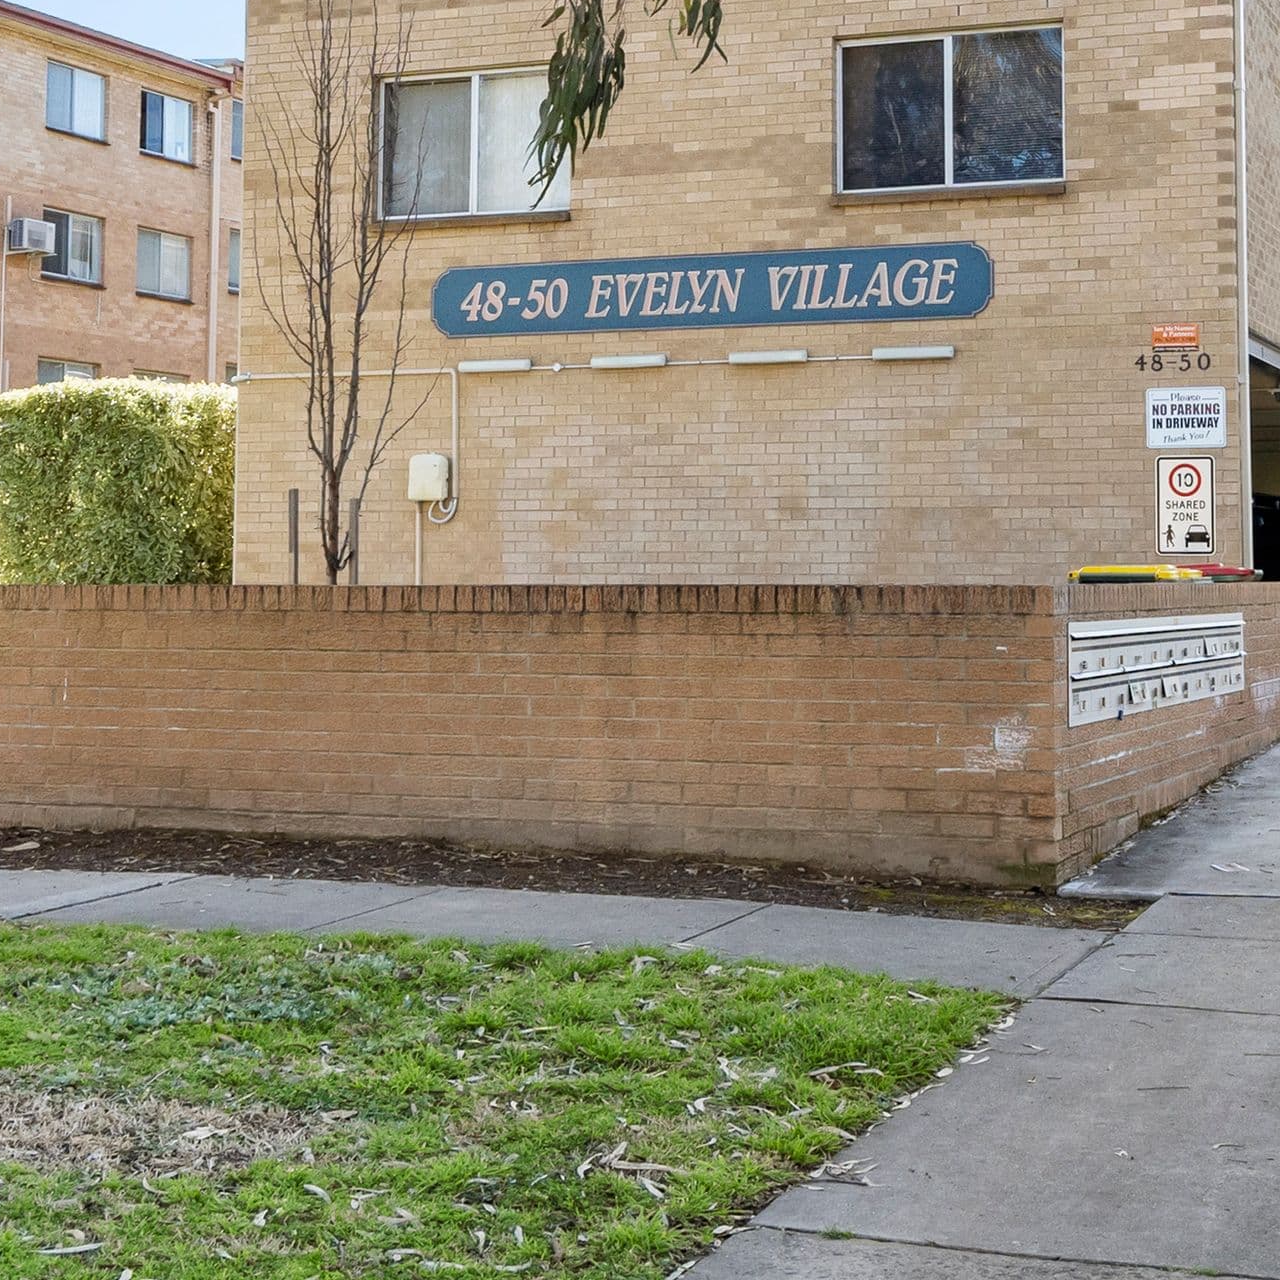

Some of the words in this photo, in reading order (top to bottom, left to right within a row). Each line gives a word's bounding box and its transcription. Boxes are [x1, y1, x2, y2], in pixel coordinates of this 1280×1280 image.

[459, 277, 568, 322] 48-50
[584, 268, 746, 319] EVELYN
[766, 258, 959, 312] VILLAGE
[1134, 352, 1211, 372] 48-50
[1170, 392, 1201, 402] Please
[1152, 404, 1167, 416] NO
[1170, 403, 1220, 416] PARKING
[1152, 418, 1163, 429] IN
[1165, 417, 1220, 429] DRIVEWAY
[1163, 433, 1187, 443] Thank
[1189, 430, 1211, 440] You!
[1177, 473, 1194, 487] 10
[1165, 500, 1206, 510] SHARED
[1172, 512, 1200, 521] ZONE
